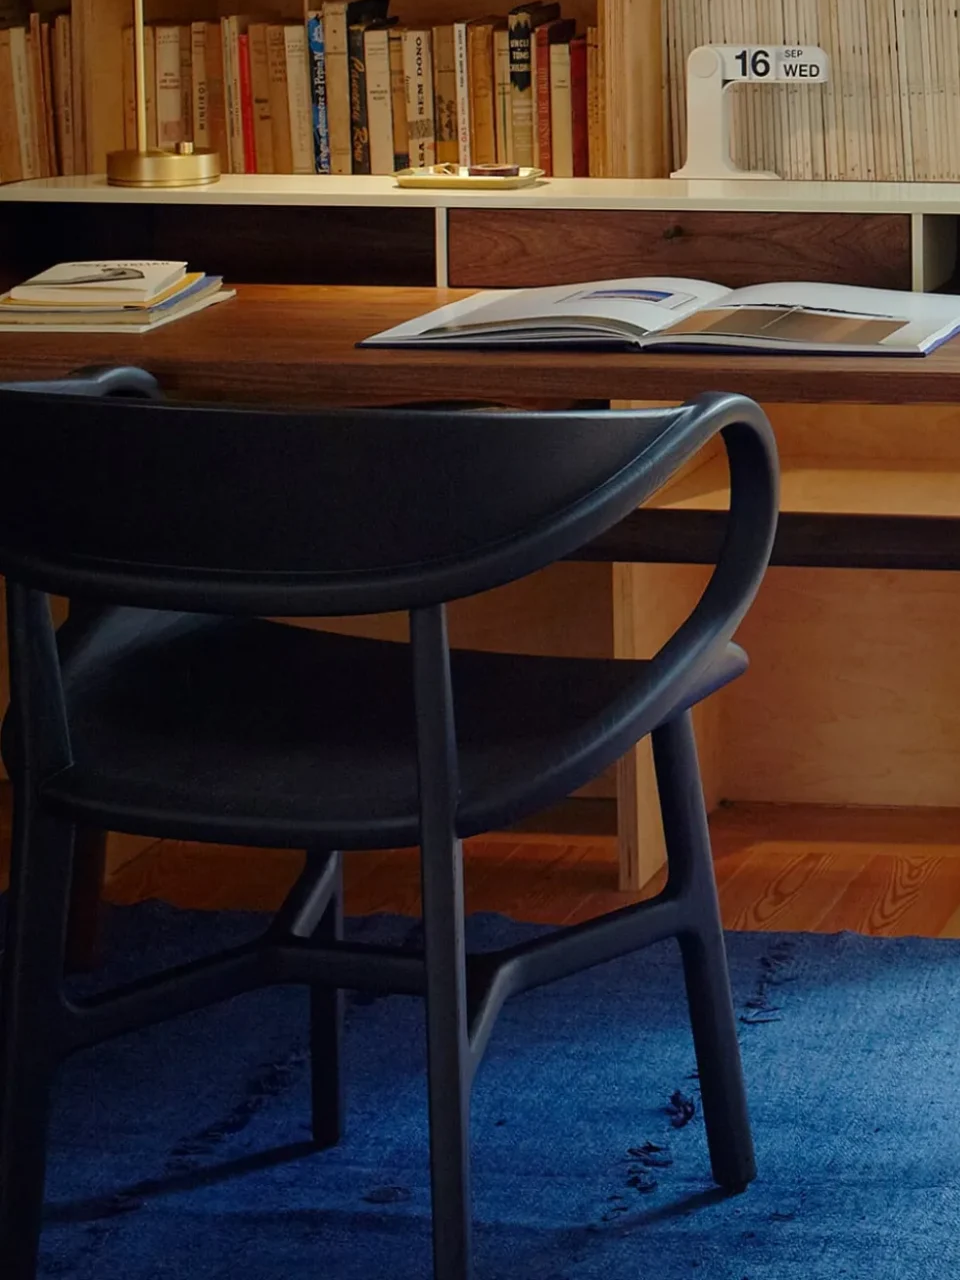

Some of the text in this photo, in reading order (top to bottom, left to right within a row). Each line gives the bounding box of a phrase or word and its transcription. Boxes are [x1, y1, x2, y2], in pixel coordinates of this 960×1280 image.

[415, 37, 423, 76] DONO
[735, 50, 770, 77] 16
[784, 50, 803, 58] SEP
[784, 64, 820, 77] WED
[417, 83, 425, 115] SEM
